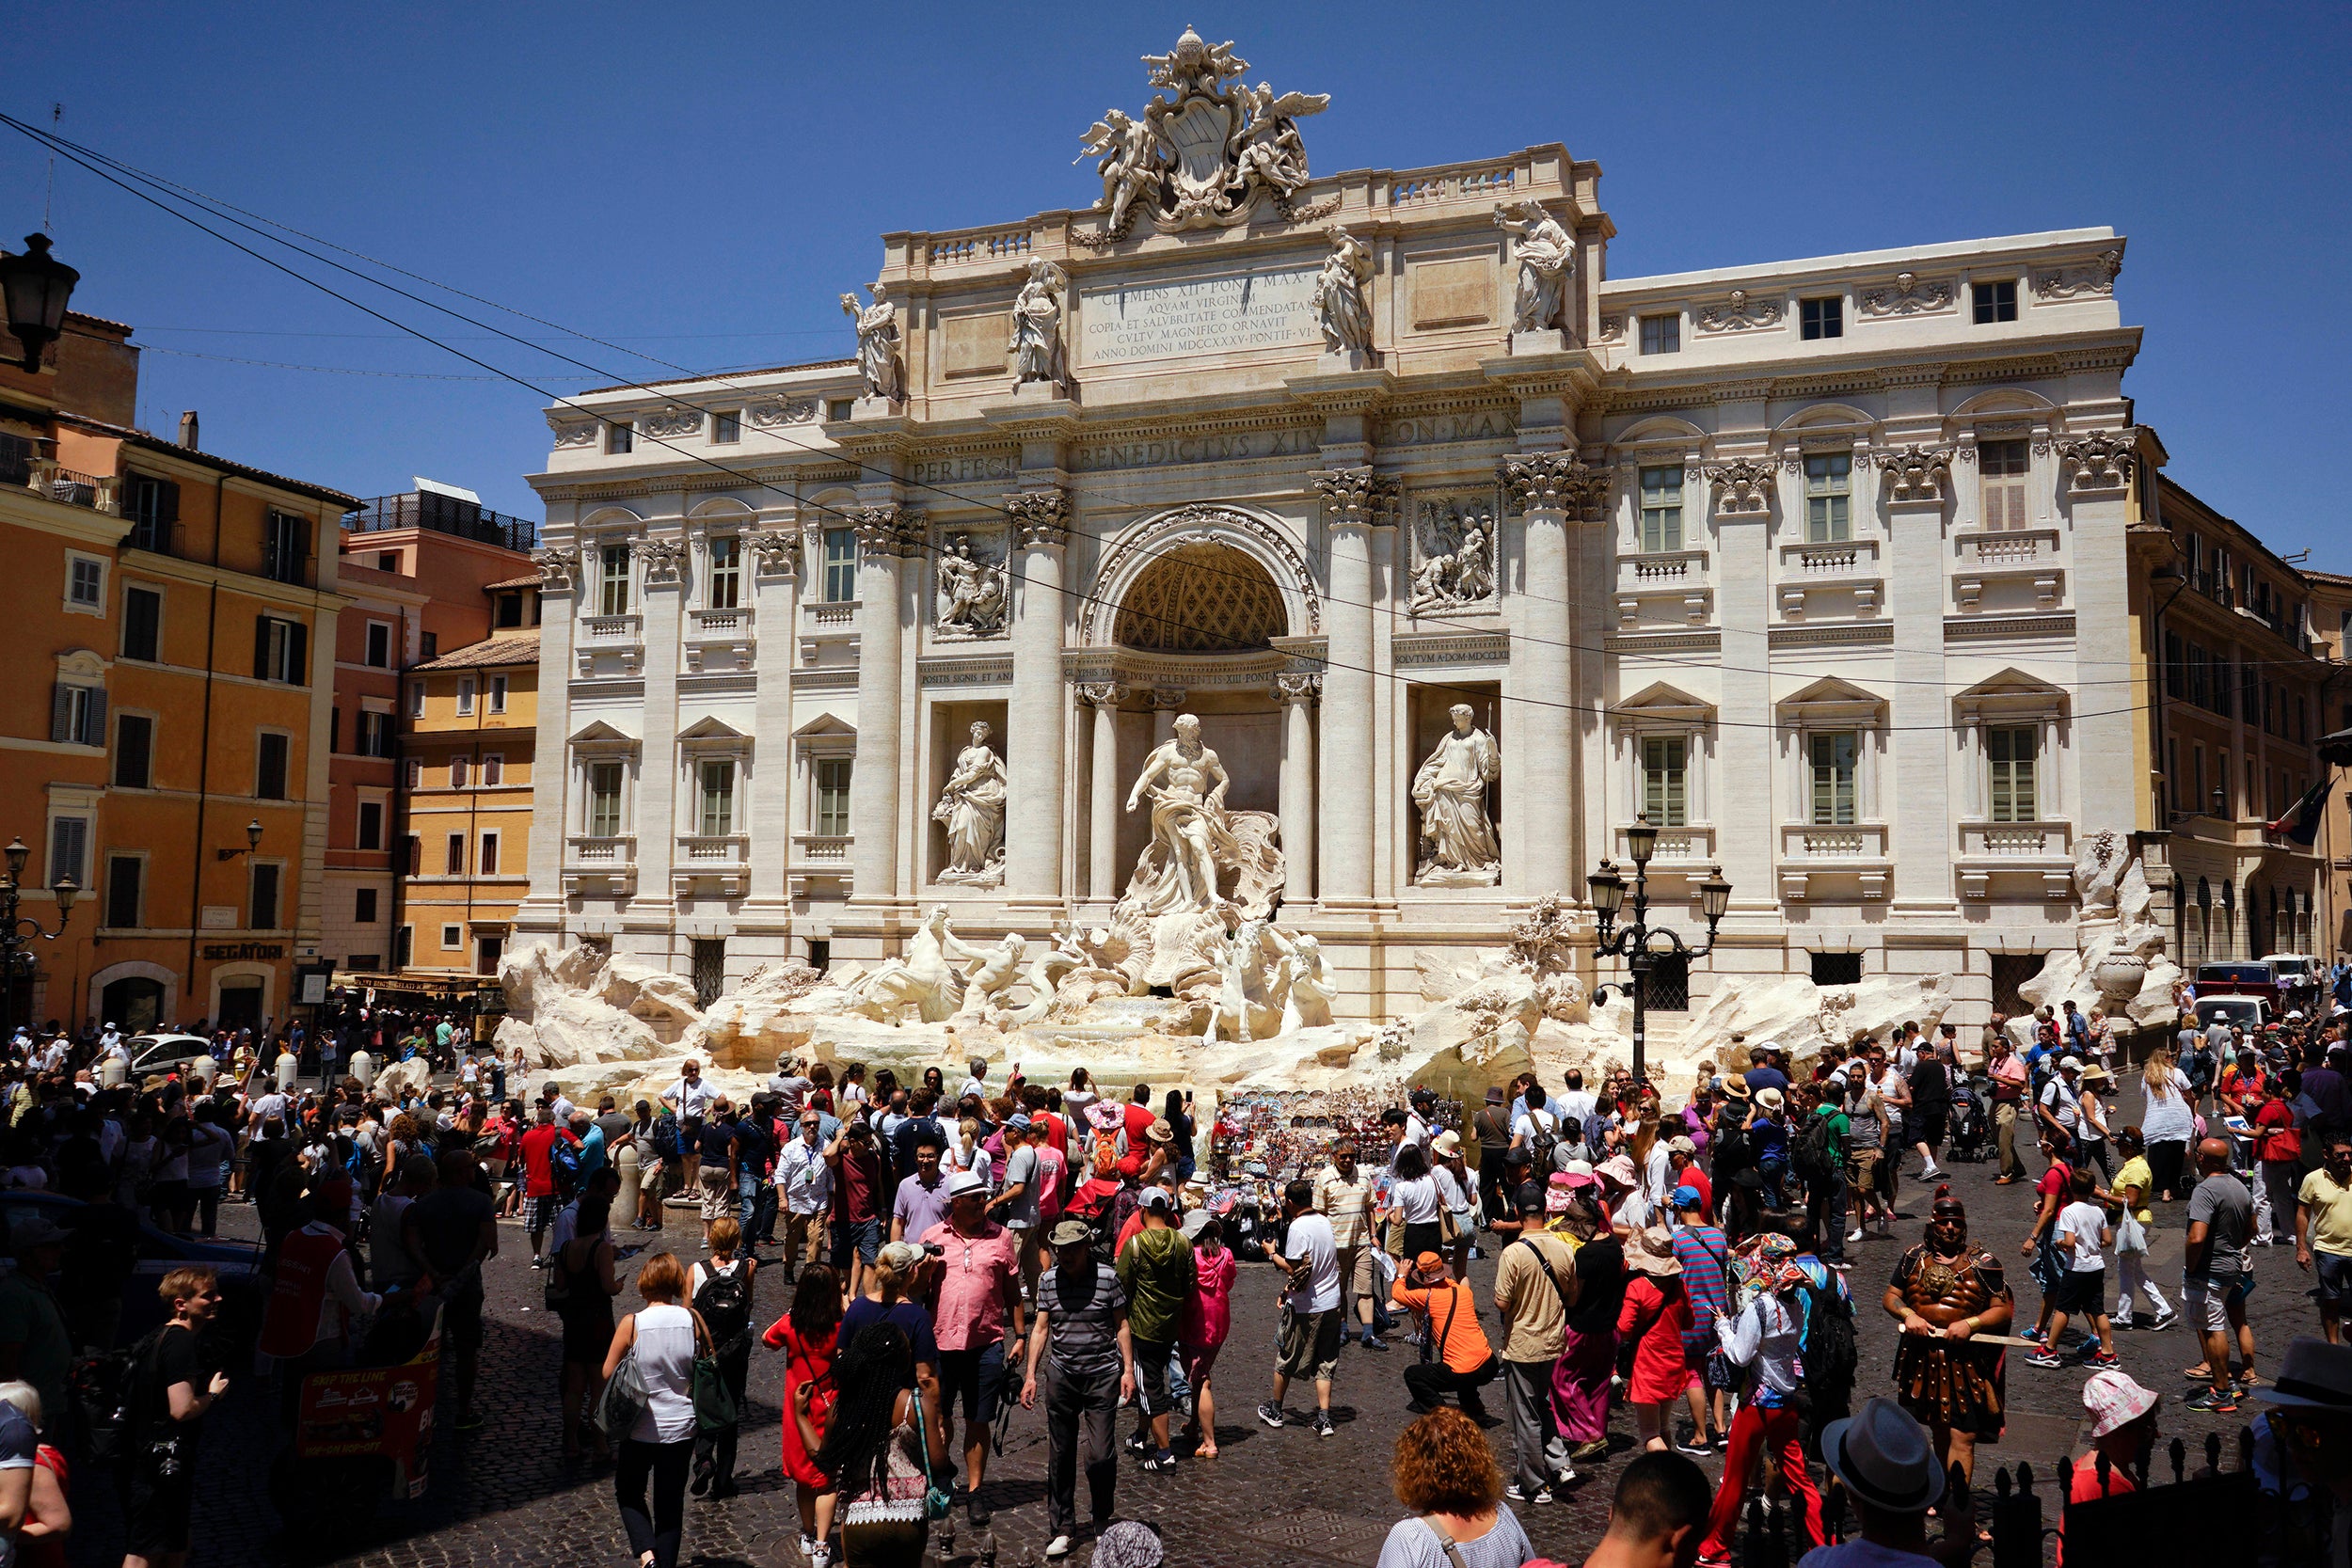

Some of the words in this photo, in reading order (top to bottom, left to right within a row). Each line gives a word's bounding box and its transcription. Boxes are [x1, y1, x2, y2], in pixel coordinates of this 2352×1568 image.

[1102, 285, 1169, 306] CLEMENS
[1147, 300, 1189, 315] AQVAM
[1196, 293, 1256, 308] VIRGINEM
[1089, 322, 1121, 334] COPIA
[1127, 319, 1139, 330] ET
[1143, 310, 1216, 328] SALVBRITATE
[1117, 330, 1154, 344] CVLTV
[1160, 323, 1228, 340] MAGNIFICO
[1232, 316, 1288, 332] ORNAVIT
[1092, 347, 1127, 360] ANNO
[1130, 342, 1172, 356] DOMINI
[1079, 435, 1249, 469] BENEDICTVS
[914, 454, 1022, 482] PERFECIT
[1395, 653, 1435, 664] SOLVTVM
[922, 674, 950, 684] POSITIS
[953, 673, 977, 683] SIGNIS
[982, 673, 992, 681] ET
[1130, 671, 1154, 682] IVSSV
[1159, 673, 1223, 685] CLEMENTIS
[311, 1374, 338, 1386] SKIP
[340, 1373, 360, 1384] THE
[360, 1371, 388, 1383] LINE
